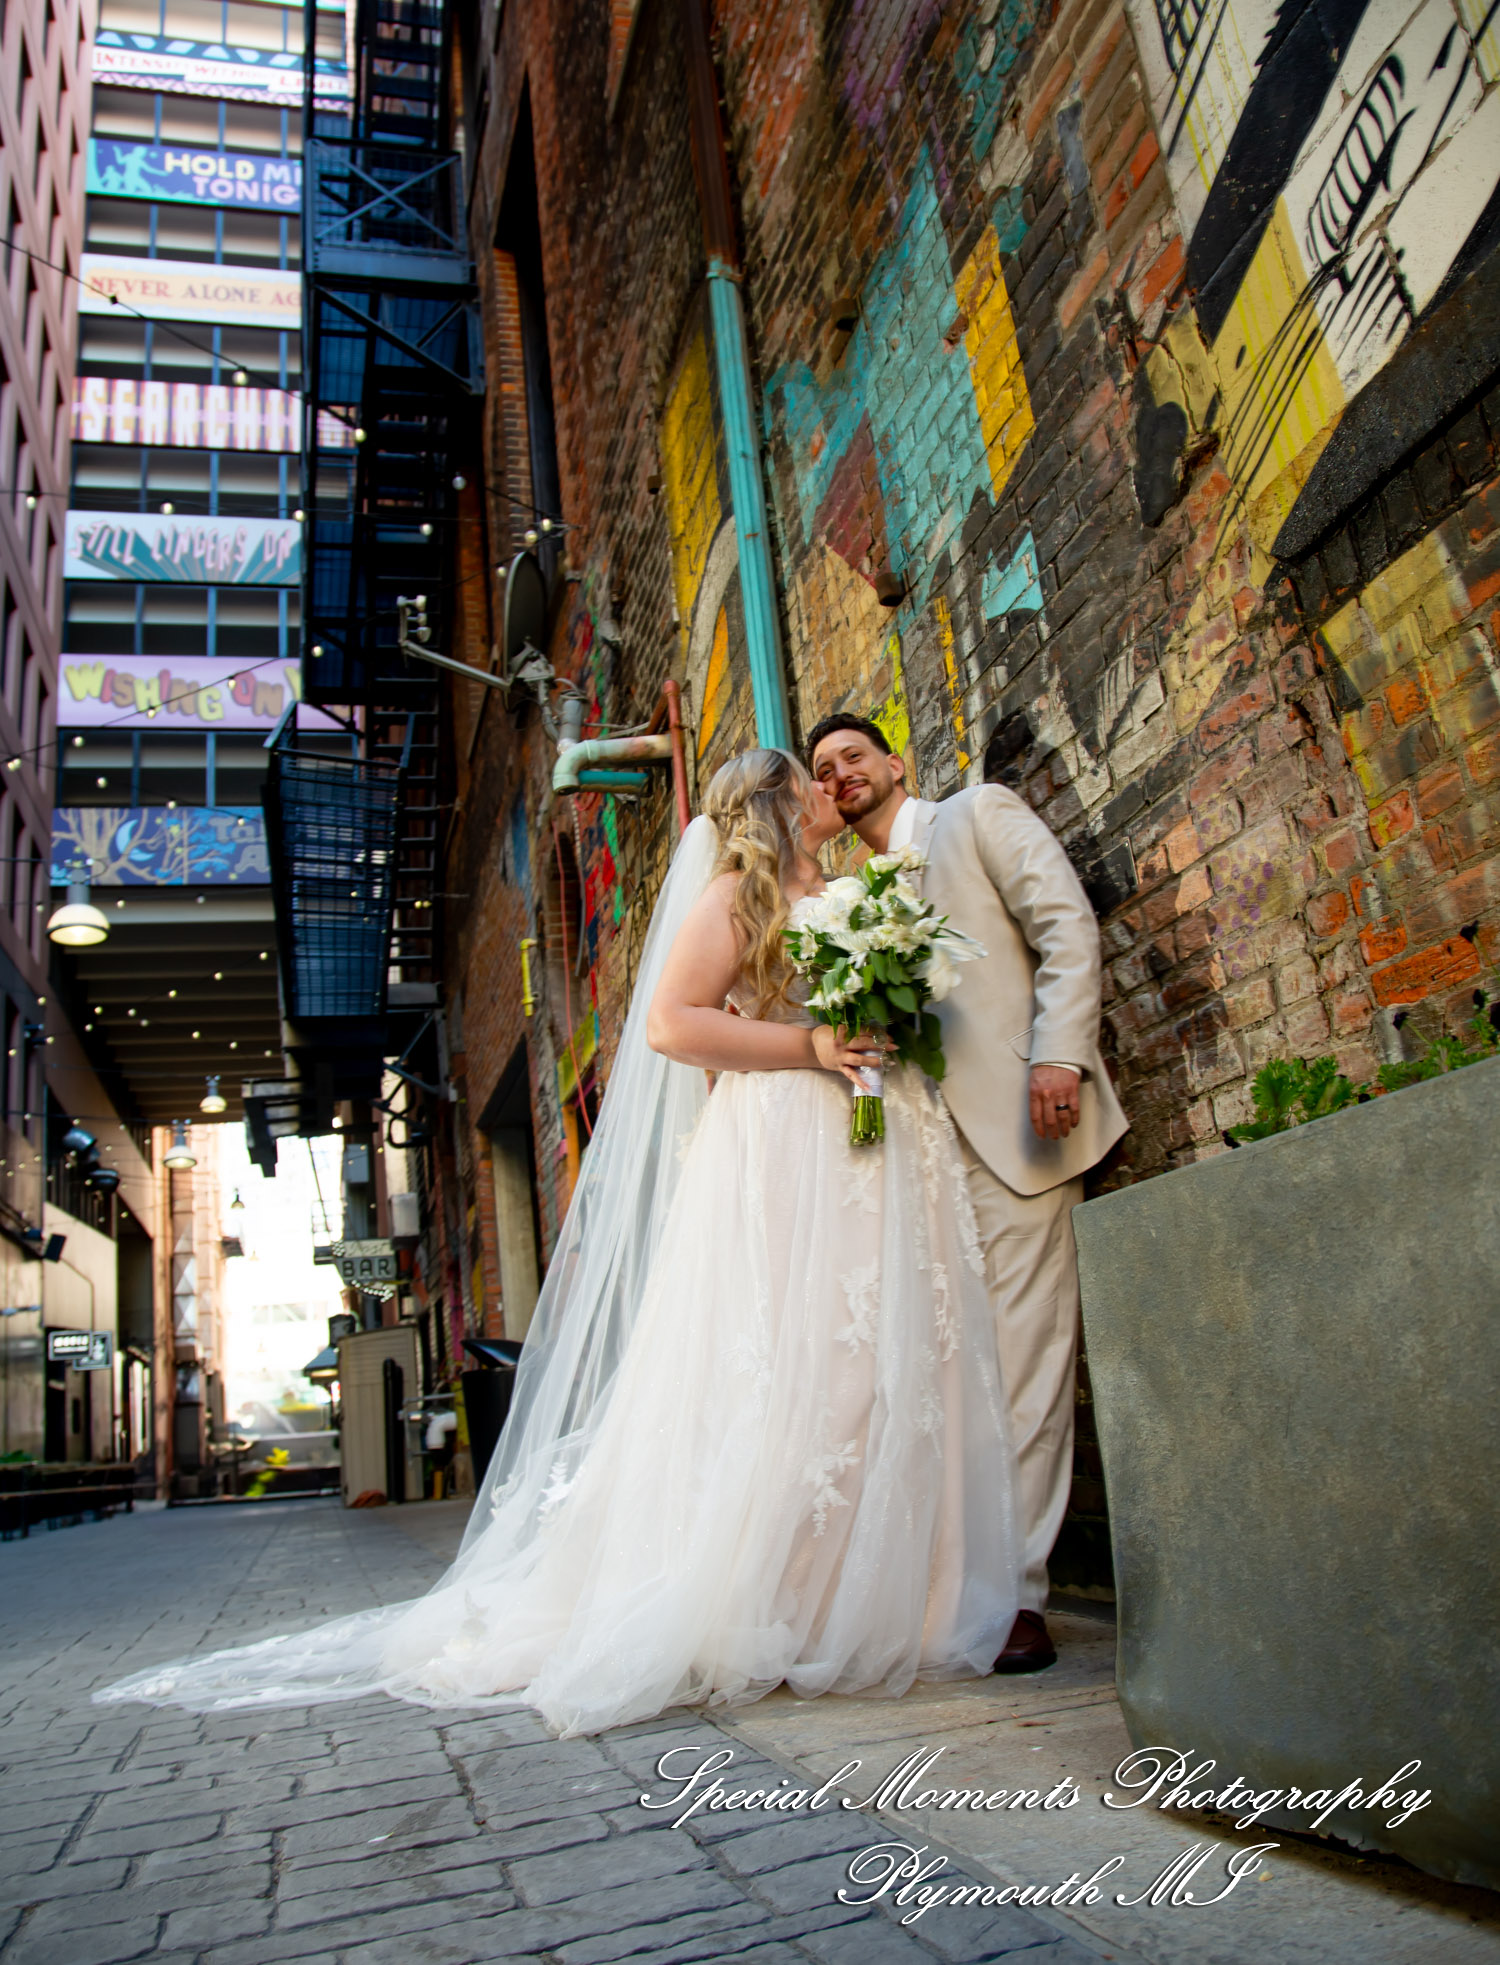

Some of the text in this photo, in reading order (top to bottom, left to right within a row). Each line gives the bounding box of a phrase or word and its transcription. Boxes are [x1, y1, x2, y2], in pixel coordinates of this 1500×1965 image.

[165, 152, 255, 177] HOLD
[193, 176, 301, 205] TONIG
[91, 276, 171, 299] NEVER
[182, 283, 262, 304] ALONE
[70, 520, 136, 566] STILL
[151, 525, 248, 572] LINGERS
[64, 662, 224, 721] WISHING
[231, 670, 284, 718] ON
[342, 1259, 390, 1278] BAR
